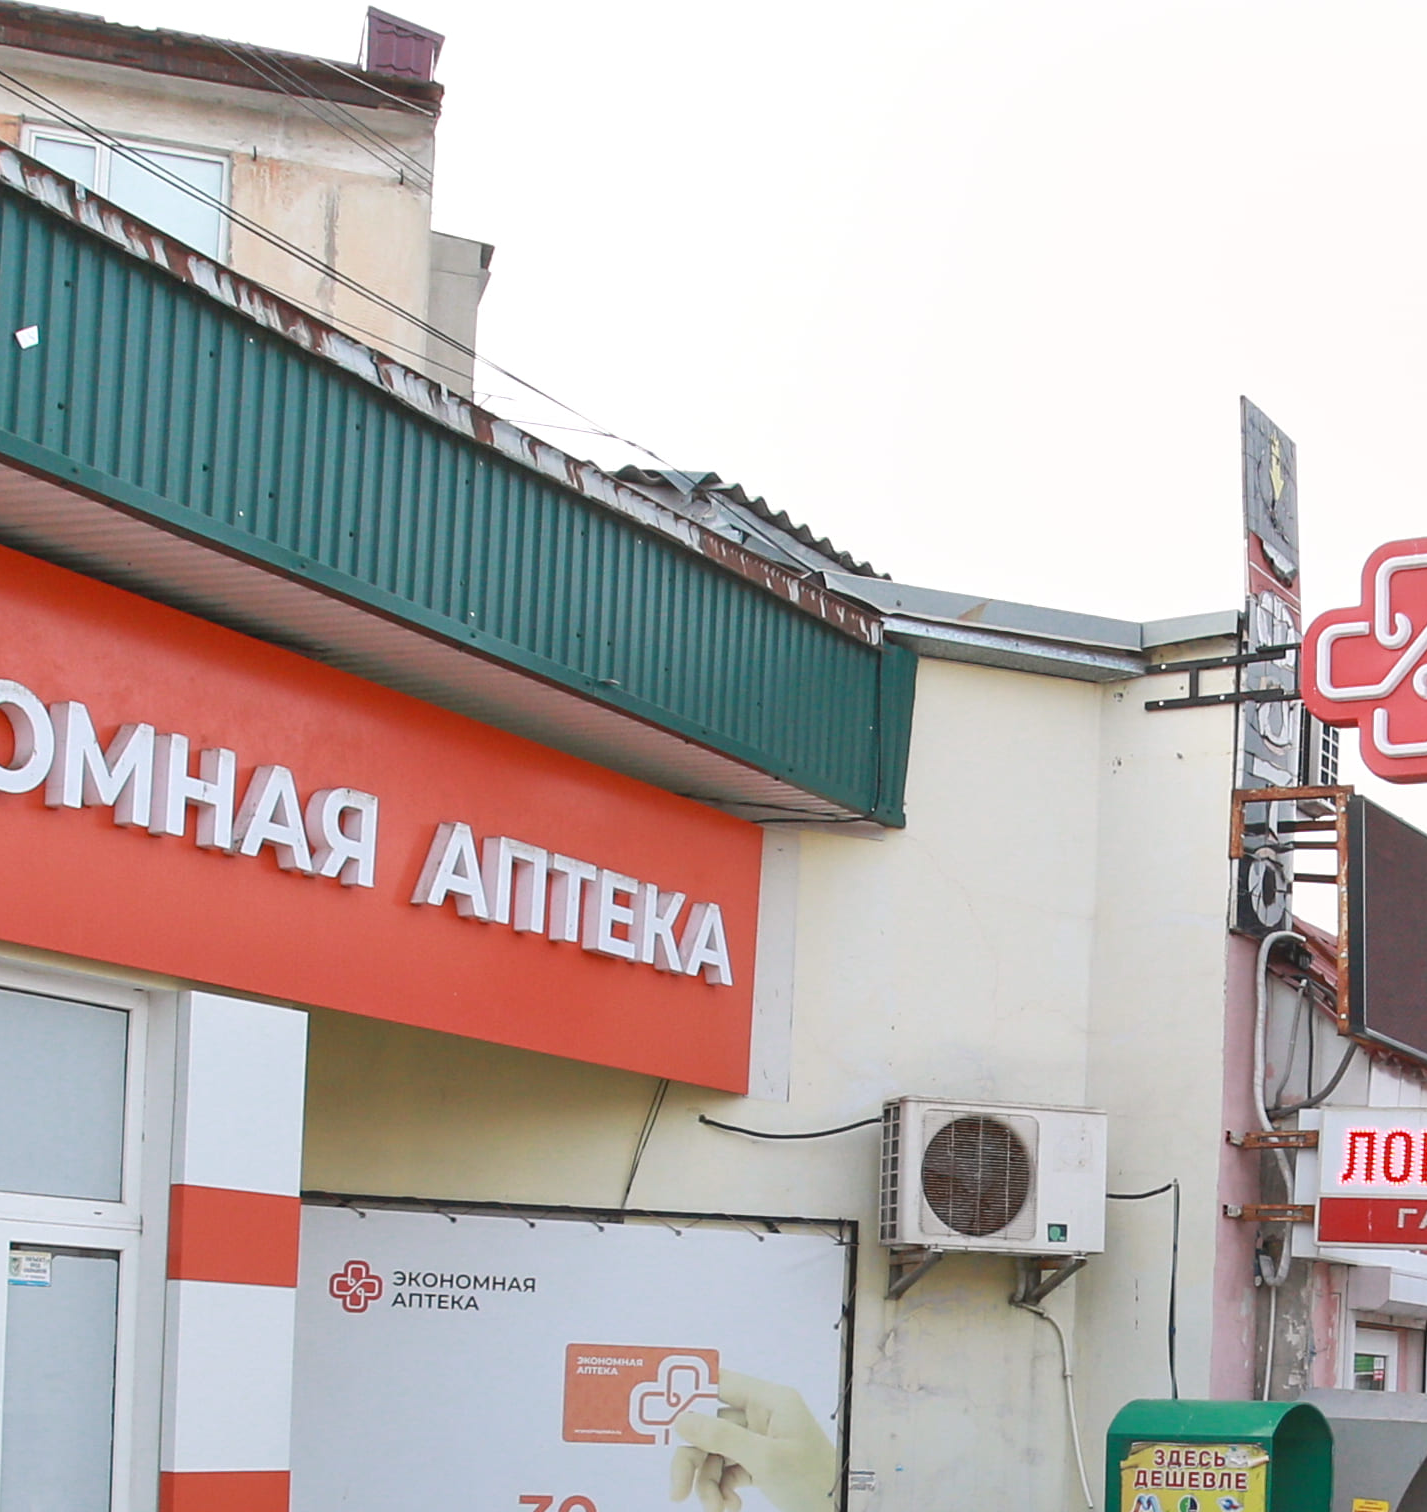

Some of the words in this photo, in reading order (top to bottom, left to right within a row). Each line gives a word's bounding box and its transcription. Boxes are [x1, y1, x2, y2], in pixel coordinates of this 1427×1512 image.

[411, 820, 733, 988] АПТЕКА
[392, 1270, 537, 1293] ЭКОНОМНАЯ
[391, 1292, 480, 1312] АПТЕКА
[576, 1356, 644, 1367] ЭКОНОМНАЯ
[576, 1366, 619, 1375] АПТЕКА
[1153, 1449, 1226, 1468] ЗДЕСЬ
[1134, 1469, 1248, 1490] ДЕШЕВЛЕ
